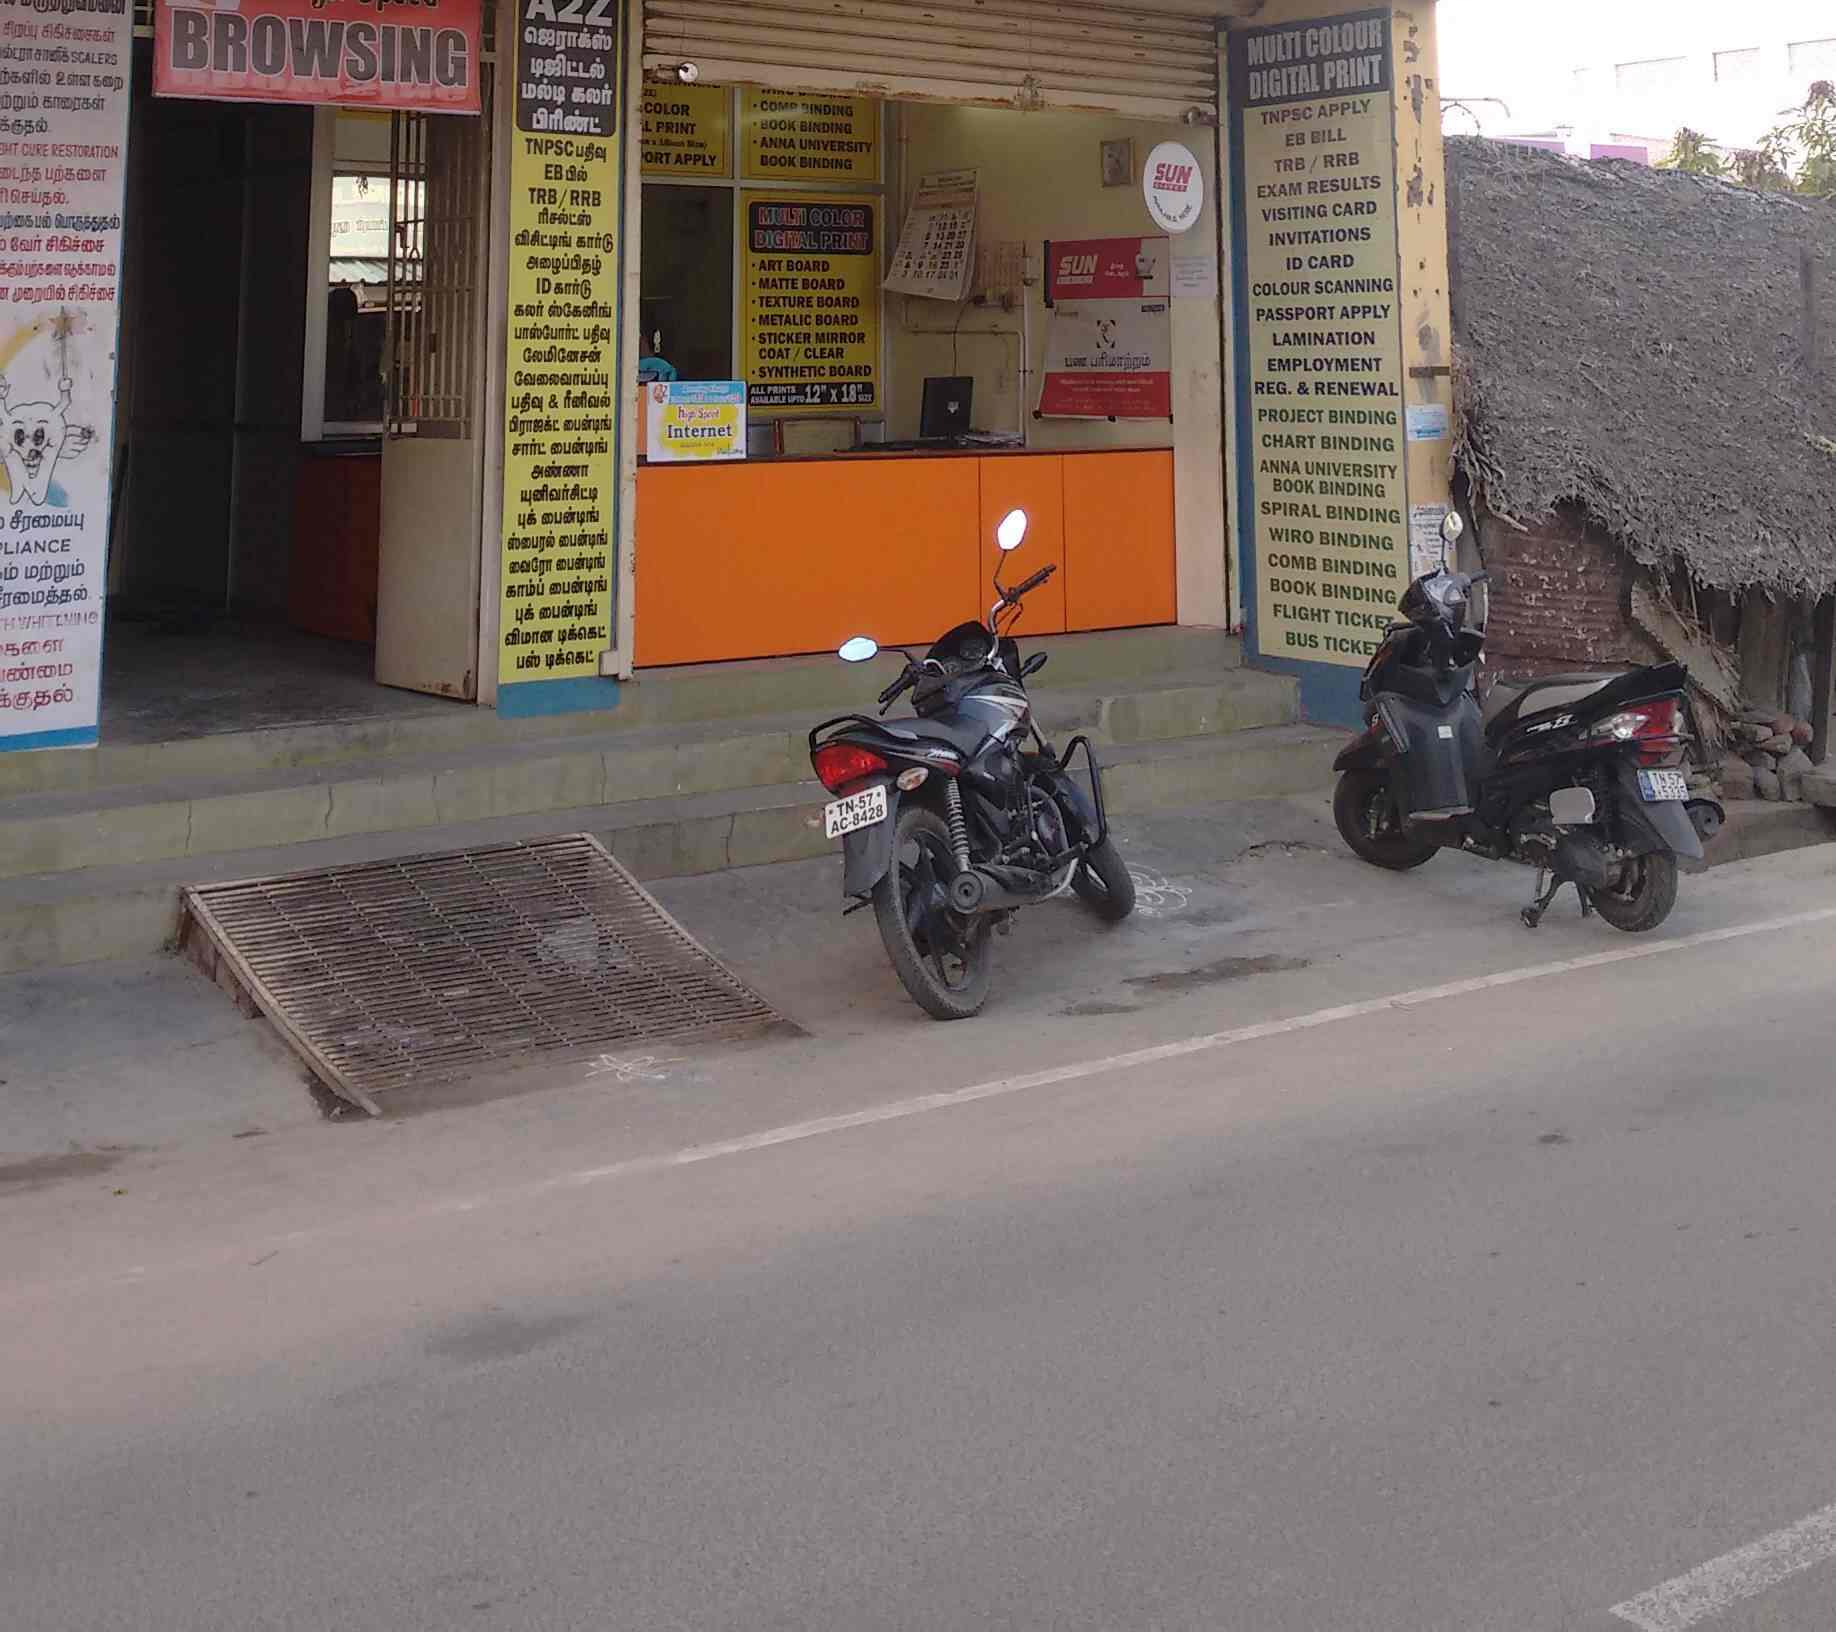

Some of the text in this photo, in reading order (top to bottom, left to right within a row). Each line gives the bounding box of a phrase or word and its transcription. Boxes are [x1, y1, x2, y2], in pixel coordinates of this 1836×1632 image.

[170, 8, 469, 89] BROWSING
[524, 26, 612, 52] ஜெராக்ஸ்
[1248, 18, 1383, 67] MULTI COLOUR
[71, 51, 117, 65] SCALERS
[530, 53, 605, 79] டிஜிட்டல்
[1249, 54, 1382, 100] DIGITAL PRINT
[522, 78, 613, 105] மல்டி கலர்
[532, 107, 601, 133] பிரிண்ட்
[1261, 98, 1372, 126] TNPSC APPLY
[1285, 128, 1347, 148] EB BILL
[525, 137, 607, 163] TNPSC பதிவு
[544, 164, 588, 181] EB பில்
[760, 155, 853, 170] BOOK BINDING
[1274, 157, 1306, 173] TRB
[1323, 152, 1360, 169] RRB
[1154, 162, 1193, 184] SUN
[528, 187, 602, 207] TRB RRB
[1257, 175, 1382, 199] EXAM RESULTS
[1262, 200, 1378, 223] VISITING CARD
[1269, 226, 1372, 247] INVITATIONS
[759, 260, 830, 273] ART BOARD
[1059, 255, 1098, 276] SUN
[1286, 254, 1355, 271] ID CARD
[536, 277, 592, 299] ID கார்டு
[759, 278, 845, 290] MATTE BOARD
[1252, 278, 1394, 297] COLOUR SCANNING
[759, 296, 860, 309] TEXTURE BOARD
[759, 314, 858, 327] METALIC BOARD
[1256, 304, 1391, 322] PASSPORT APPLY
[759, 332, 865, 344] STICKER MIRROR
[1272, 331, 1376, 347] LAMINATION
[759, 347, 844, 360] COAT CLEAR
[759, 365, 872, 379] SYNTHETIC BOARD
[1267, 357, 1382, 373] EMPLOYMENT
[1255, 381, 1399, 397] REG. & RENEWAL
[1258, 408, 1324, 423] PROJECT
[1328, 410, 1397, 425] BINDING
[667, 424, 733, 438] Internet
[1262, 433, 1395, 452] CHART BINDING
[531, 461, 589, 480] அண்ணா
[1259, 459, 1398, 479] ANNA UNIVERSITY
[1273, 478, 1386, 498] BOOK BINDING
[1260, 501, 1401, 524] SPIRAL BINDING
[1268, 527, 1394, 551] WIRO BINDING
[24, 558, 85, 583] மற்றும்
[1267, 553, 1397, 578] COMB BINDING
[1270, 578, 1397, 605] BOOK BINDING
[1273, 603, 1331, 624] FLIGHT
[1286, 632, 1378, 658] BUS TICKE
[516, 650, 541, 669] பஸ்
